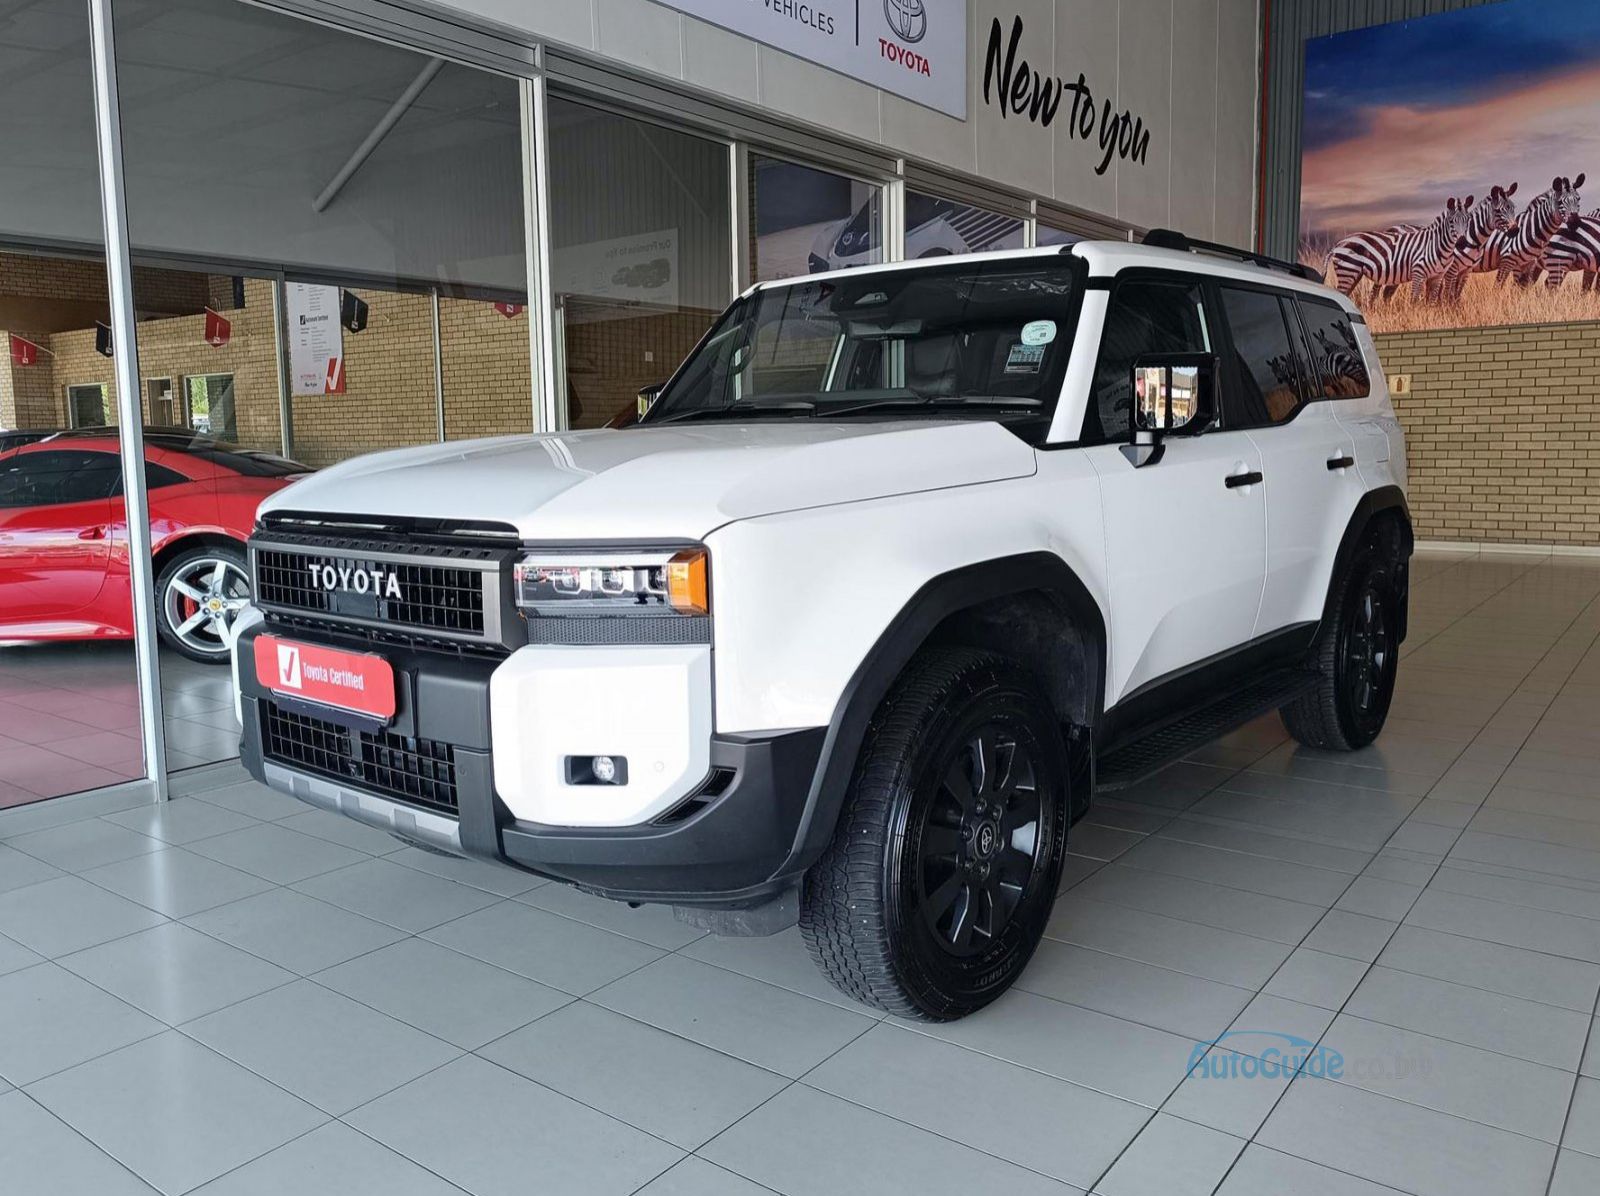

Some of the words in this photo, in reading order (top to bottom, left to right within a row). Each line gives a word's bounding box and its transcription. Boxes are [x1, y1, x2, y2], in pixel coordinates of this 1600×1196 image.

[879, 38, 931, 77] TOYOTA
[983, 15, 1062, 127] New
[1063, 72, 1096, 140] to
[1094, 98, 1150, 176] you
[308, 564, 402, 599] TOYOTA
[303, 662, 328, 683] Toyota
[330, 668, 365, 691] Certified
